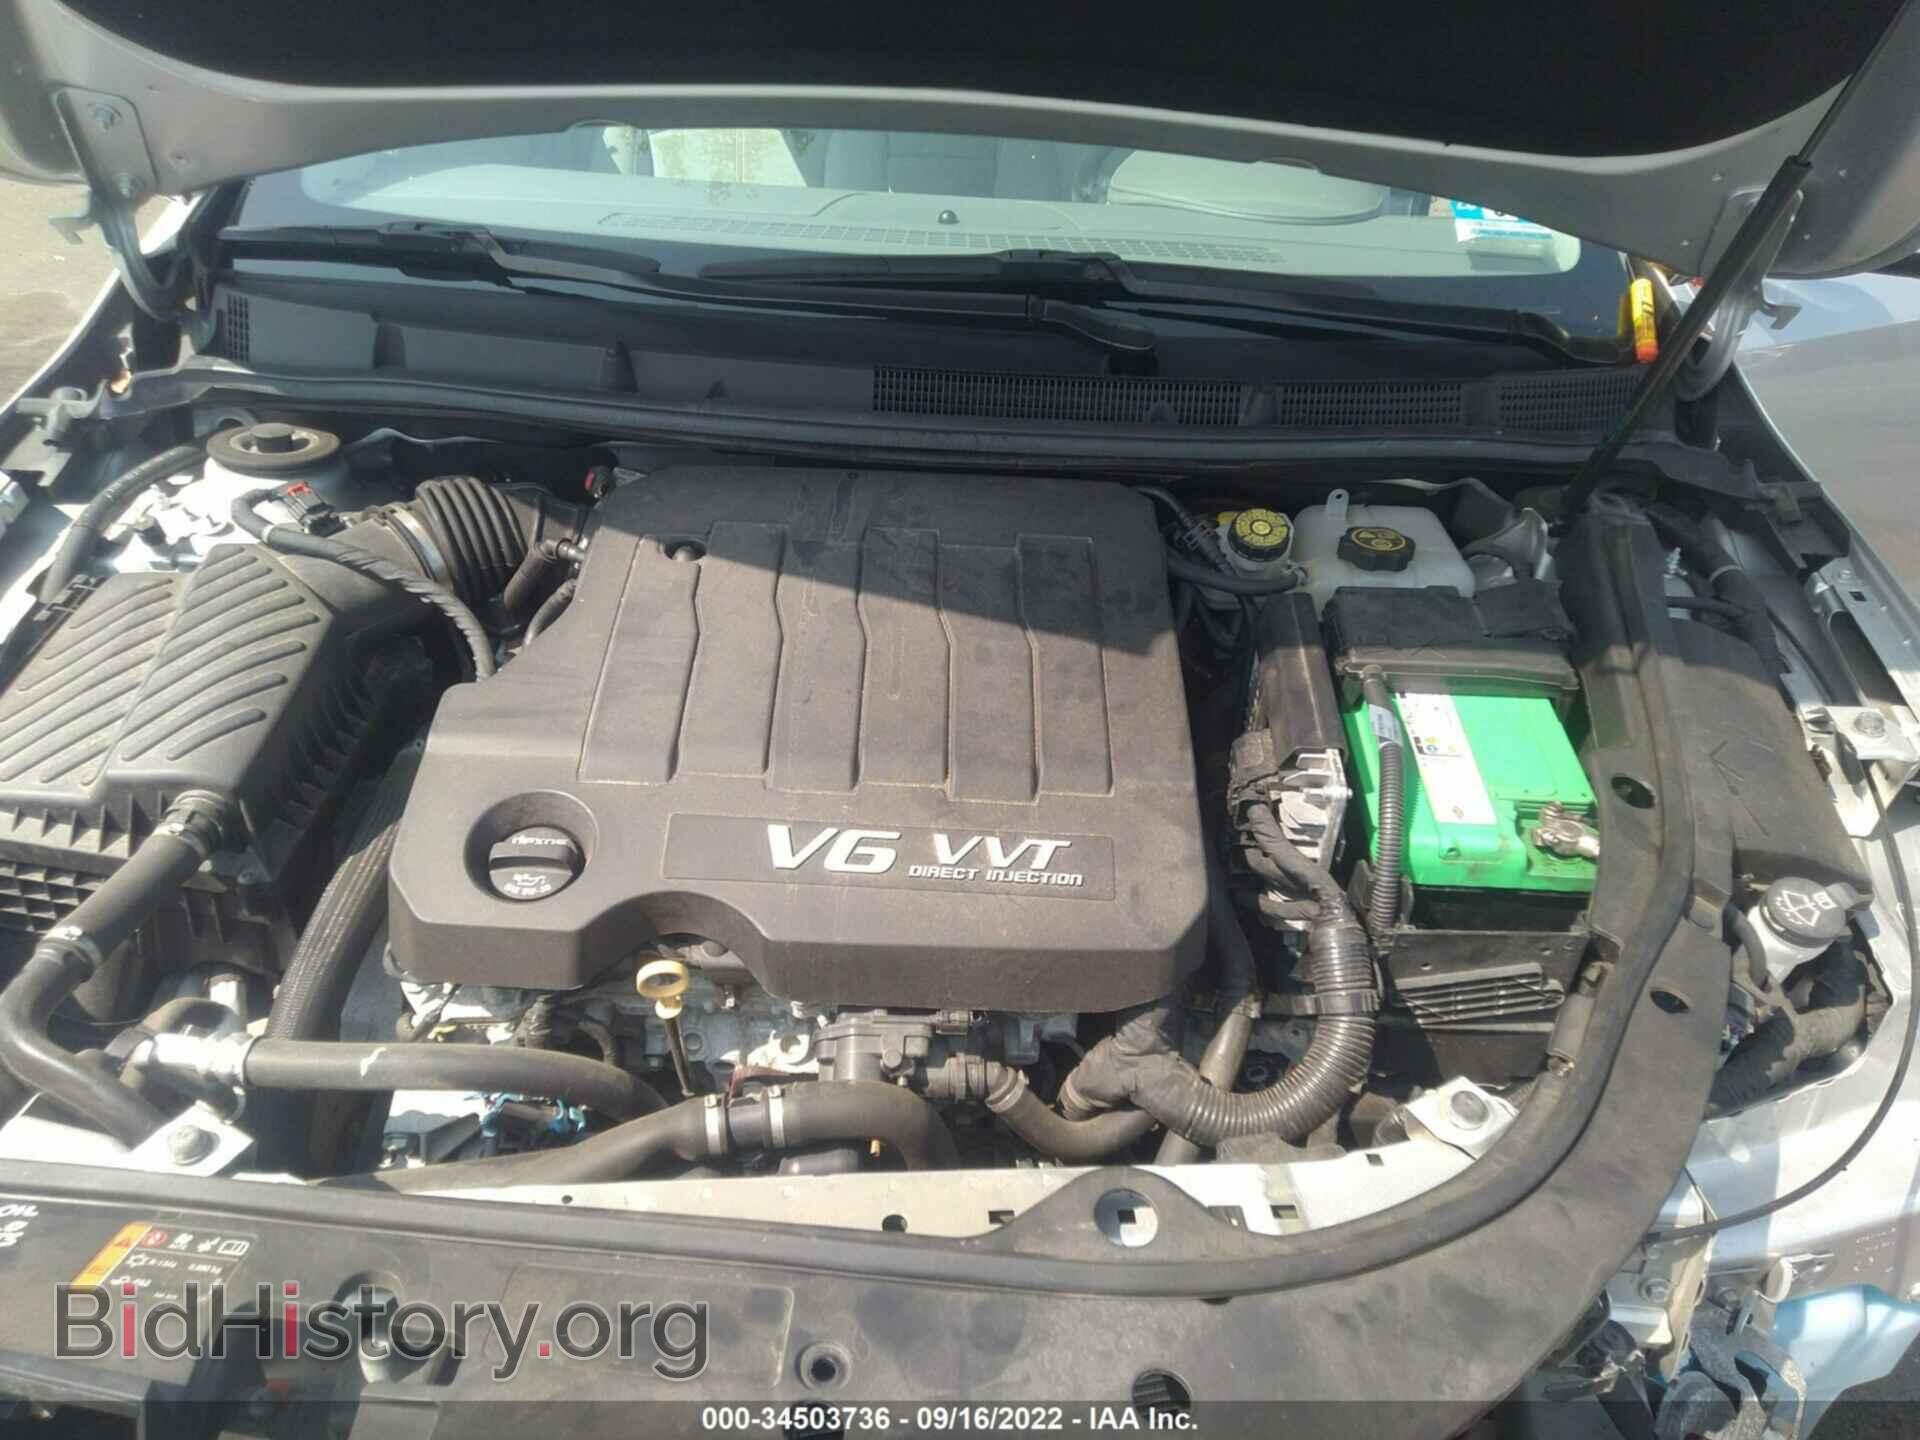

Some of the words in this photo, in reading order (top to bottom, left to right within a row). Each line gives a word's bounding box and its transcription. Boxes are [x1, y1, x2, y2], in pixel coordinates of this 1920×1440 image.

[767, 824, 900, 873] V6
[932, 833, 1073, 871] VVT
[908, 867, 980, 880] DIRECT
[986, 870, 1085, 886] INJECTION
